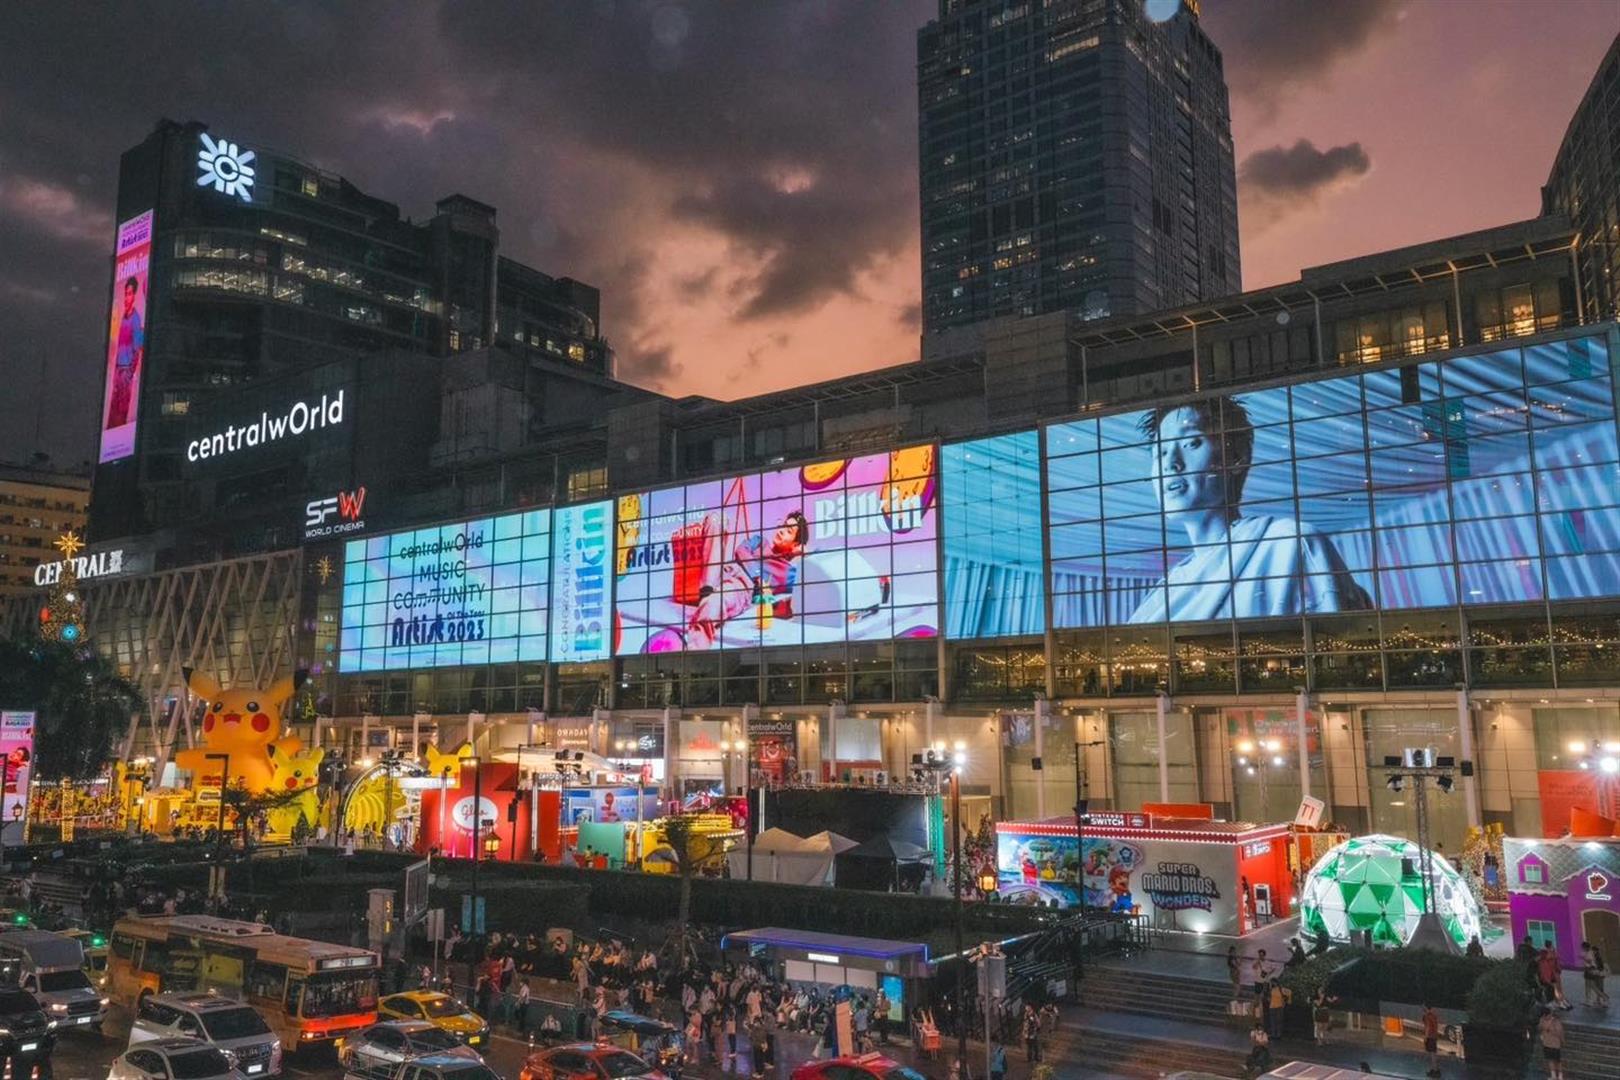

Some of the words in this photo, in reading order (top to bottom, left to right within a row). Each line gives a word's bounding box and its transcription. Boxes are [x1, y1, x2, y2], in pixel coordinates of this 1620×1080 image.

[187, 389, 344, 462] centralwOrld
[305, 486, 366, 526] SFW
[814, 487, 923, 541] Billkin
[305, 526, 332, 538] WORLD
[333, 520, 365, 534] CINEMA
[400, 530, 484, 559] centralwOrld
[626, 543, 671, 569] Artist
[419, 560, 465, 583] MUSIC
[573, 506, 605, 652] Billkin
[392, 614, 444, 646] Artist
[447, 619, 485, 641] 2023
[1090, 818, 1125, 827] SWITCH
[1159, 862, 1197, 875] SUPER
[1142, 873, 1181, 894] MARIO
[1181, 875, 1218, 896] BROS.
